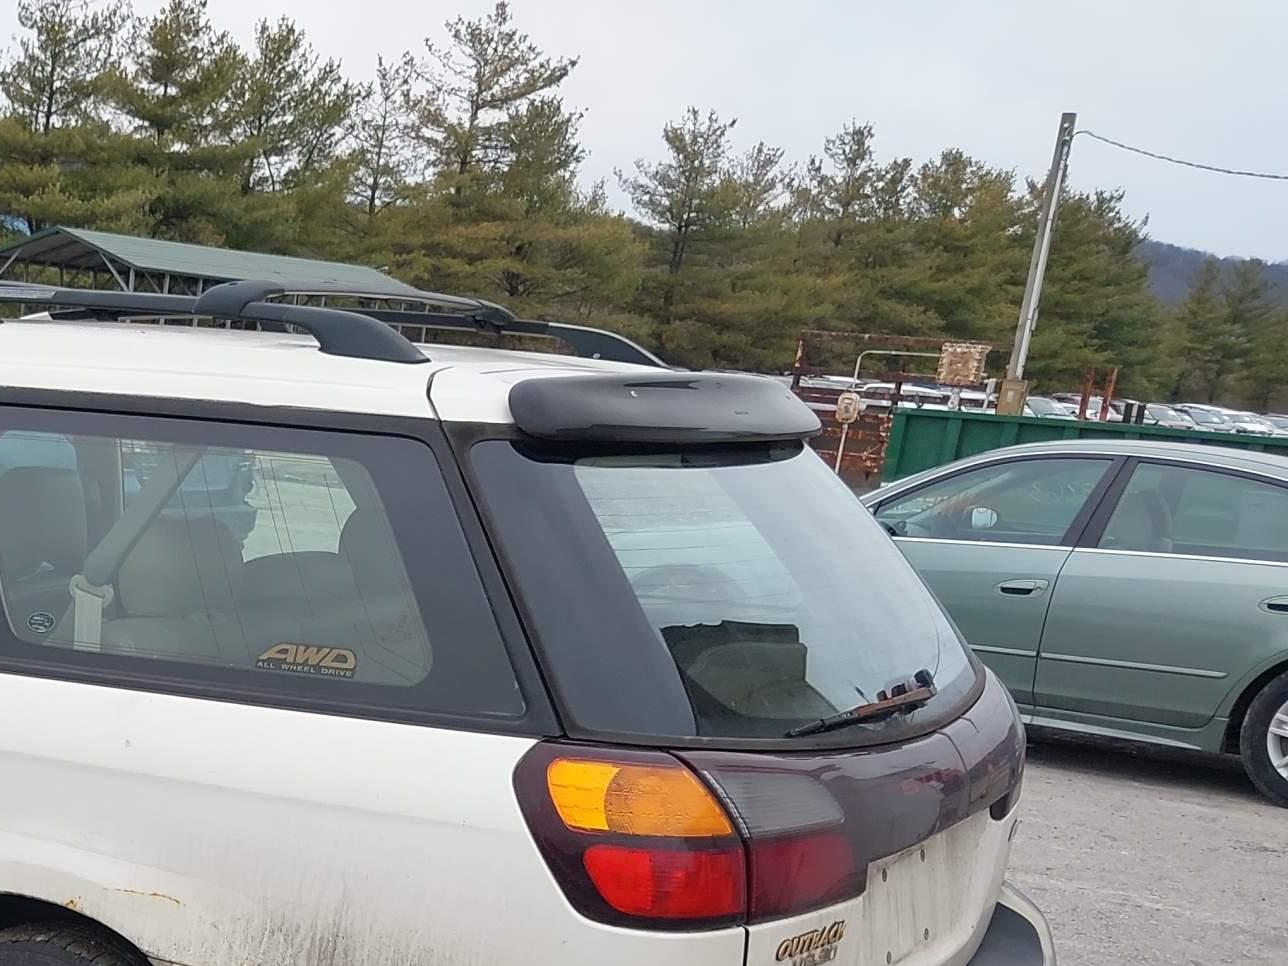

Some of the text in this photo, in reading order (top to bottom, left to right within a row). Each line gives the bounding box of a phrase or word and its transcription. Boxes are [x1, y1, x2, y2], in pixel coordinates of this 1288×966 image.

[256, 661, 353, 677] ALL WHEEL DRIVE
[258, 642, 357, 670] AWD
[776, 919, 847, 962] OUTBACK
